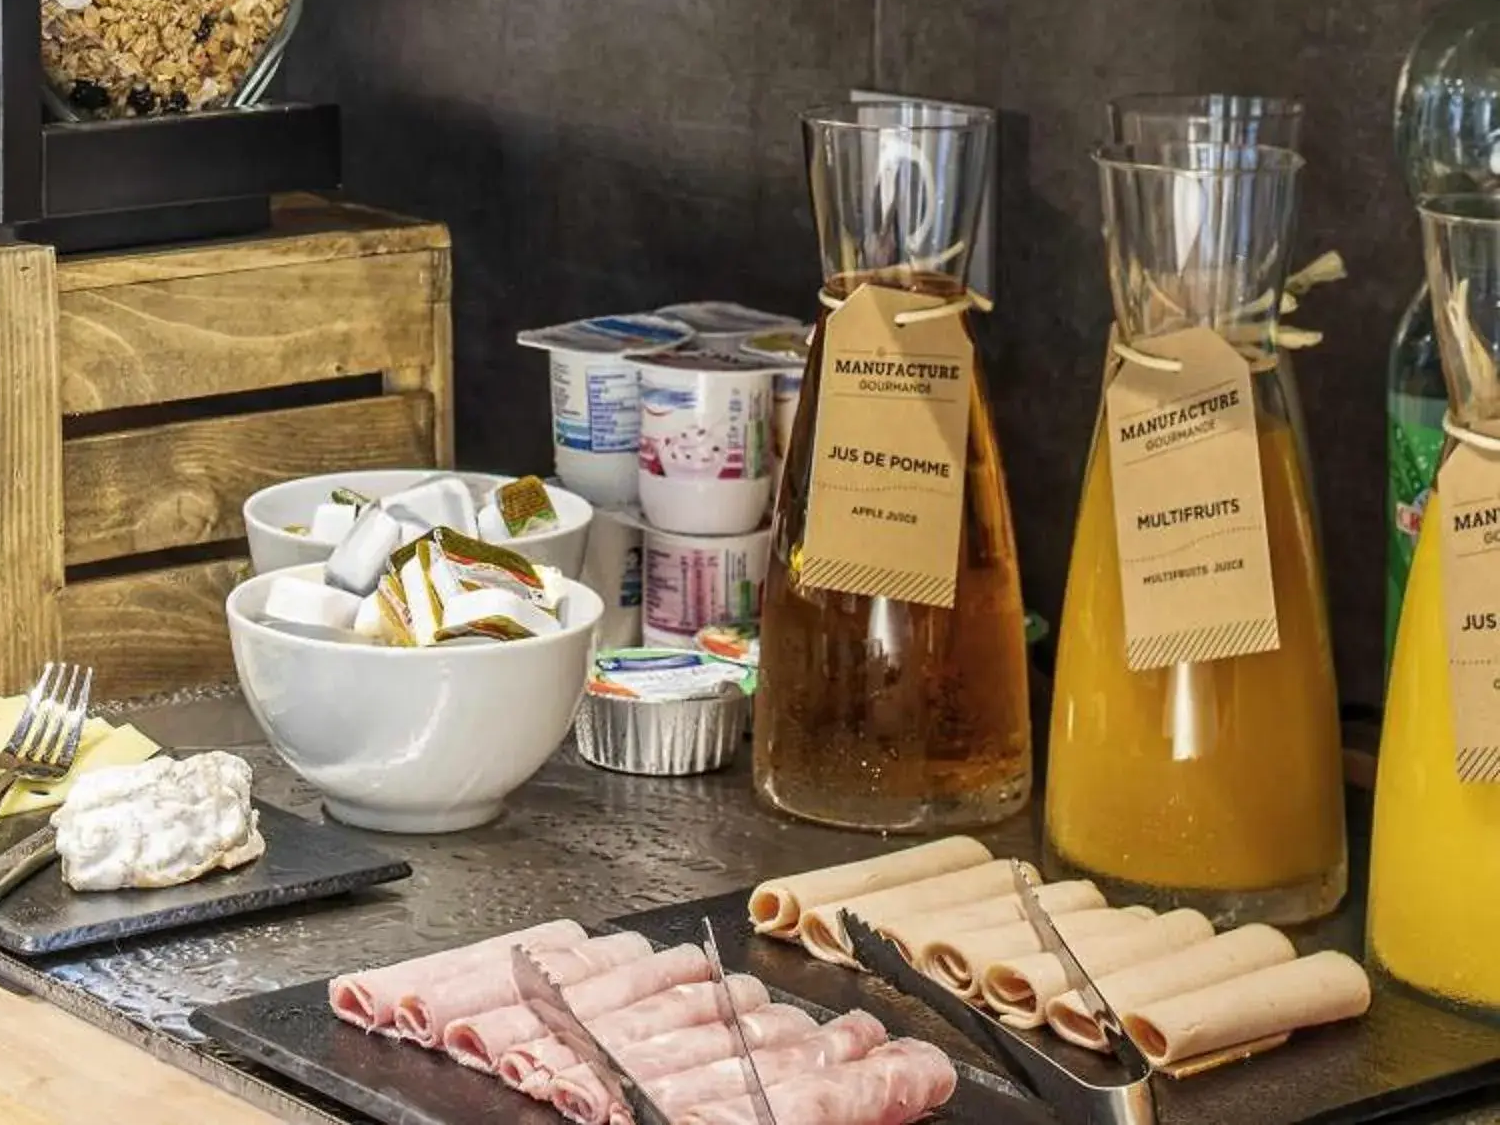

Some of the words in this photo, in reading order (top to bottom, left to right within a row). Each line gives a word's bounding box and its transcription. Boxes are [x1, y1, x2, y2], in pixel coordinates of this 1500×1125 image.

[834, 358, 960, 381] MANUFACTURE
[858, 378, 932, 395] GOURMANDE
[1119, 390, 1240, 443] MANUFACTURE
[1145, 417, 1217, 453] GOURMANDE
[828, 445, 859, 463] JUS
[863, 450, 886, 468] DE
[890, 455, 951, 478] POMME
[851, 505, 884, 520] APPLE
[886, 511, 918, 525] JUICE
[1137, 498, 1241, 530] MULTIFRUITS
[1453, 508, 1500, 532] MAN
[1143, 565, 1209, 585] MULTIFRUITS
[1213, 558, 1245, 574] JUICE
[1462, 613, 1498, 632] JUS
